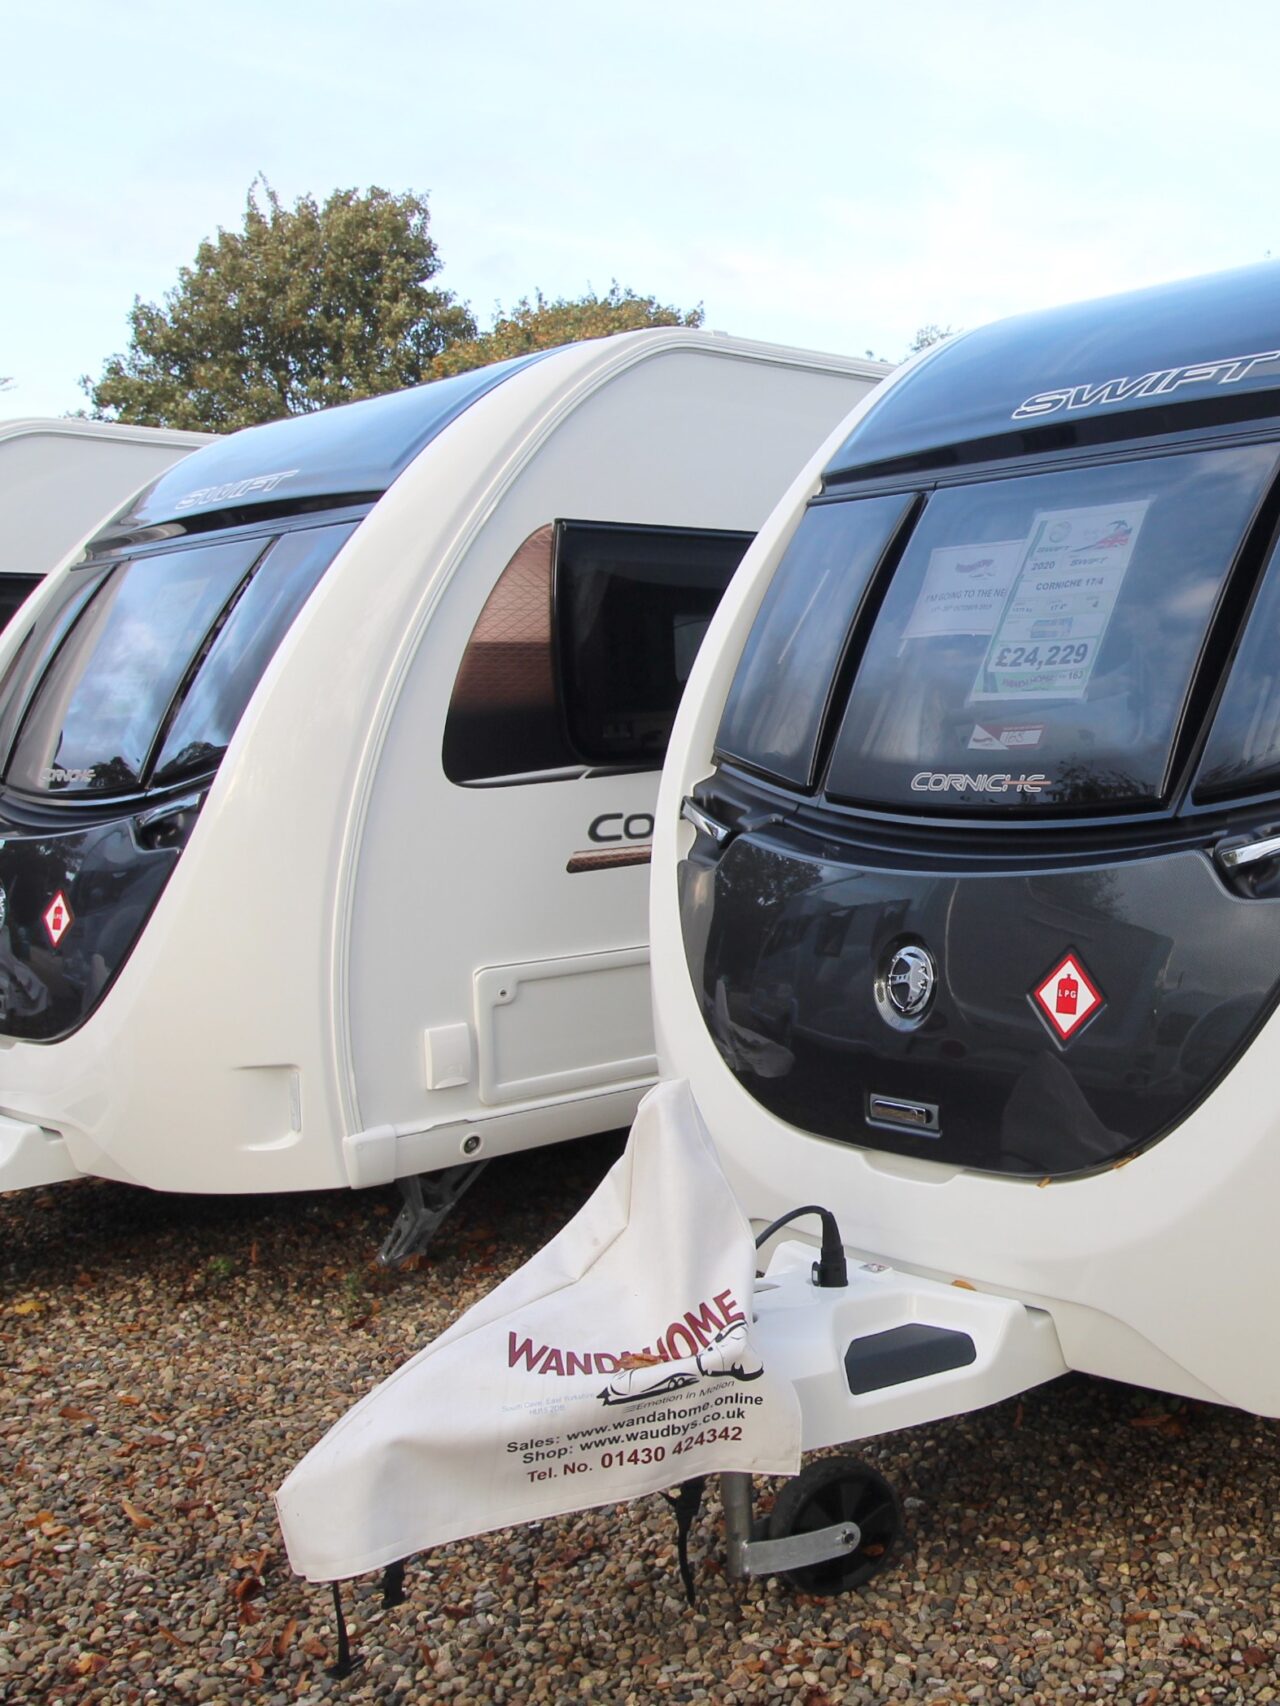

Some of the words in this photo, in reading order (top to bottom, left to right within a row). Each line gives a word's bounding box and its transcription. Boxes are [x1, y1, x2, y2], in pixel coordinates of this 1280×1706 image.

[175, 469, 299, 510] SWIFT
[1031, 560, 1056, 571] 2020
[964, 589, 976, 598] TO
[977, 588, 992, 598] THE
[1035, 579, 1082, 591] CORNICHE
[995, 643, 1089, 671] £24,229
[911, 772, 1051, 792] CORNICHE
[1058, 989, 1077, 999] LPG
[636, 1393, 683, 1410] Emotion
[686, 1391, 696, 1399] in
[699, 1380, 735, 1397] Motion
[506, 1436, 560, 1453] Sales:
[566, 1392, 764, 1441] www.wandahome.online
[522, 1445, 574, 1464] Shop:
[580, 1408, 746, 1451] www.waudbys.co.uk
[527, 1467, 557, 1483] Tel.
[563, 1462, 593, 1475] No.
[601, 1446, 666, 1468] 01430
[671, 1426, 743, 1455] 424342
